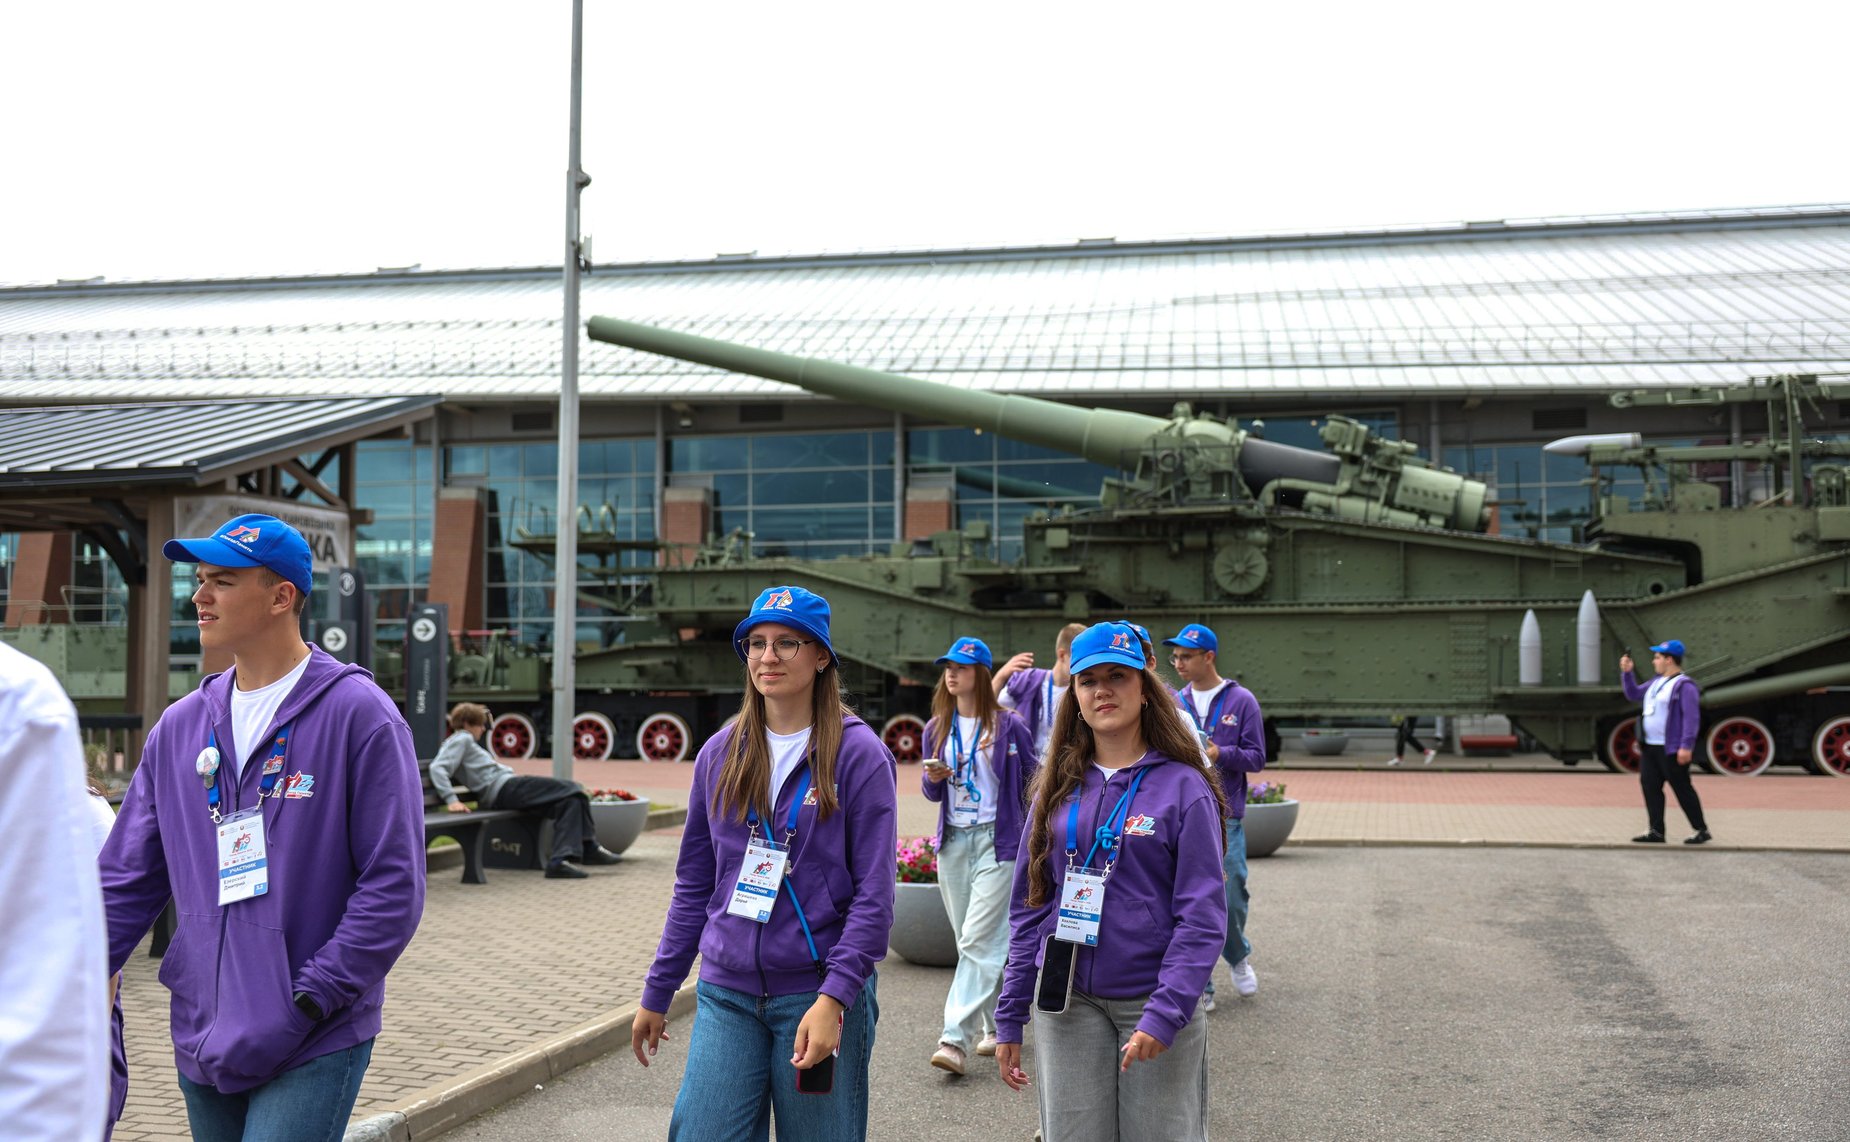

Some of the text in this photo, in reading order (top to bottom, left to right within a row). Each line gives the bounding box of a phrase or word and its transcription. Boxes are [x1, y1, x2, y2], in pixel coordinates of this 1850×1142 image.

[229, 862, 257, 874] УЧАСТНИК
[744, 884, 769, 894] УЧАСТНИК
[1067, 910, 1092, 919] УЧАСТНИК
